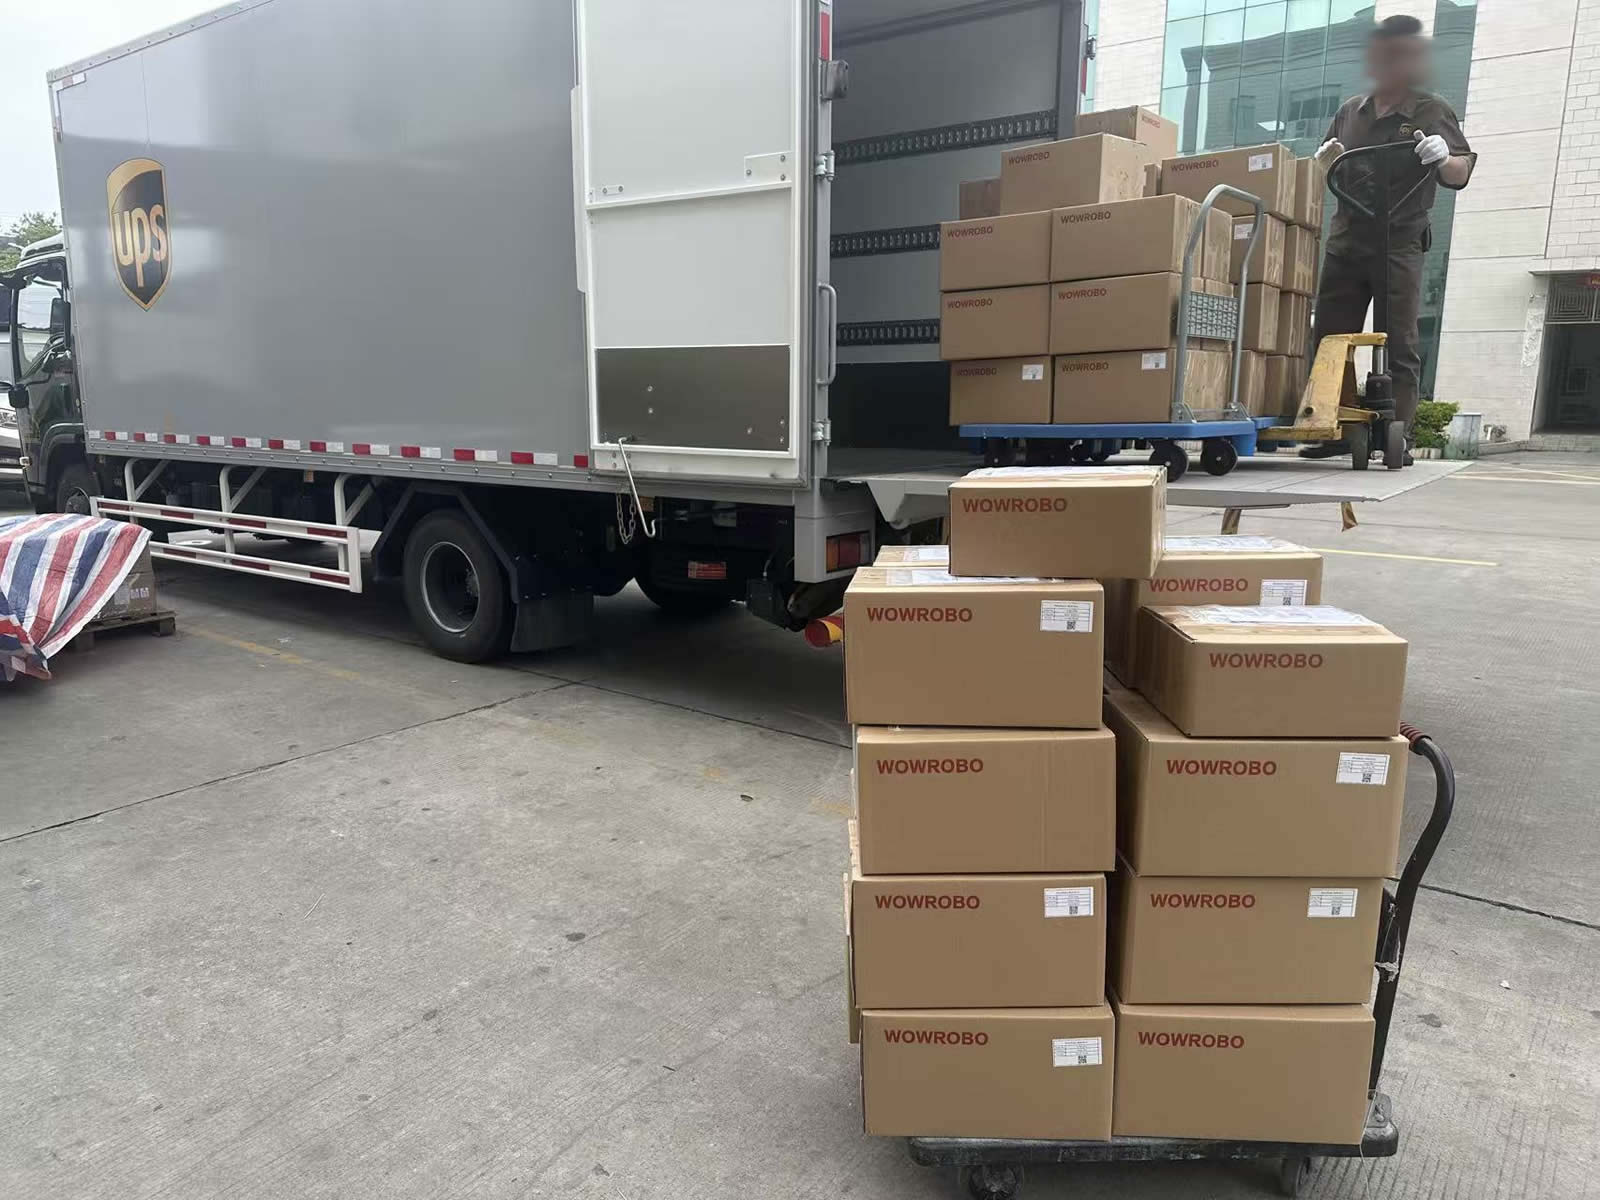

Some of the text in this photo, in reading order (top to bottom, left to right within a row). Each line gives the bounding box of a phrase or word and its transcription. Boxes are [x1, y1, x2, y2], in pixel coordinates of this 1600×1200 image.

[1008, 151, 1050, 165] WOWROBO
[1170, 158, 1219, 172] WOWROBO
[1061, 210, 1111, 225] WOWROBO
[947, 226, 993, 238] WOWROBO
[113, 204, 167, 288] ups
[1058, 287, 1107, 301] WOWROBO
[947, 298, 993, 309] WOWROBO
[1061, 361, 1109, 372] WOWROBO
[962, 497, 1068, 513] WOWROBO
[1149, 577, 1249, 593] WOWROBO
[866, 607, 973, 623] WOWROBO
[1208, 652, 1324, 669] WOWROBO
[876, 758, 984, 775] WOWROBO
[1166, 759, 1277, 776] WOWROBO
[874, 894, 980, 910] WOWROBO
[1150, 893, 1256, 909] WOWROBO
[884, 1029, 989, 1046] WOWROBO
[1137, 1031, 1245, 1049] WOWROBO
